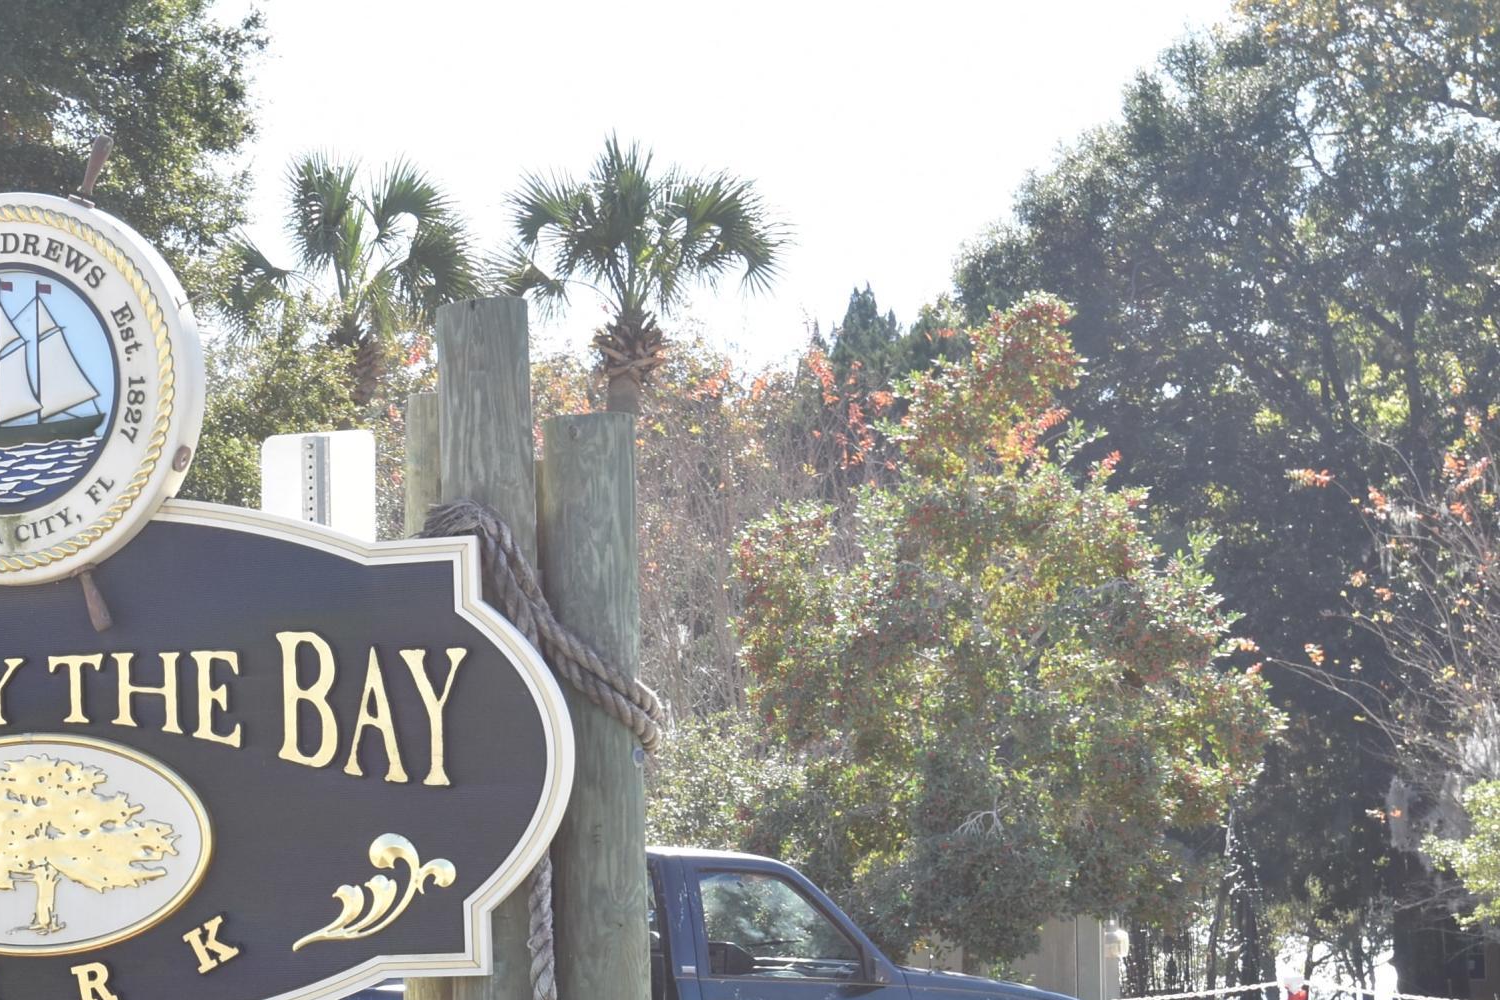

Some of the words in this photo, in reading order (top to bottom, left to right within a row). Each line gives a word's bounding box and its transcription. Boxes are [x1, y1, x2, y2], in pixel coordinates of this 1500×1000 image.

[110, 301, 144, 362] Est.
[122, 375, 146, 444] 1827
[14, 507, 83, 544] CITY,
[85, 476, 115, 505] FL
[47, 650, 242, 748] THE
[275, 631, 468, 786] BAY
